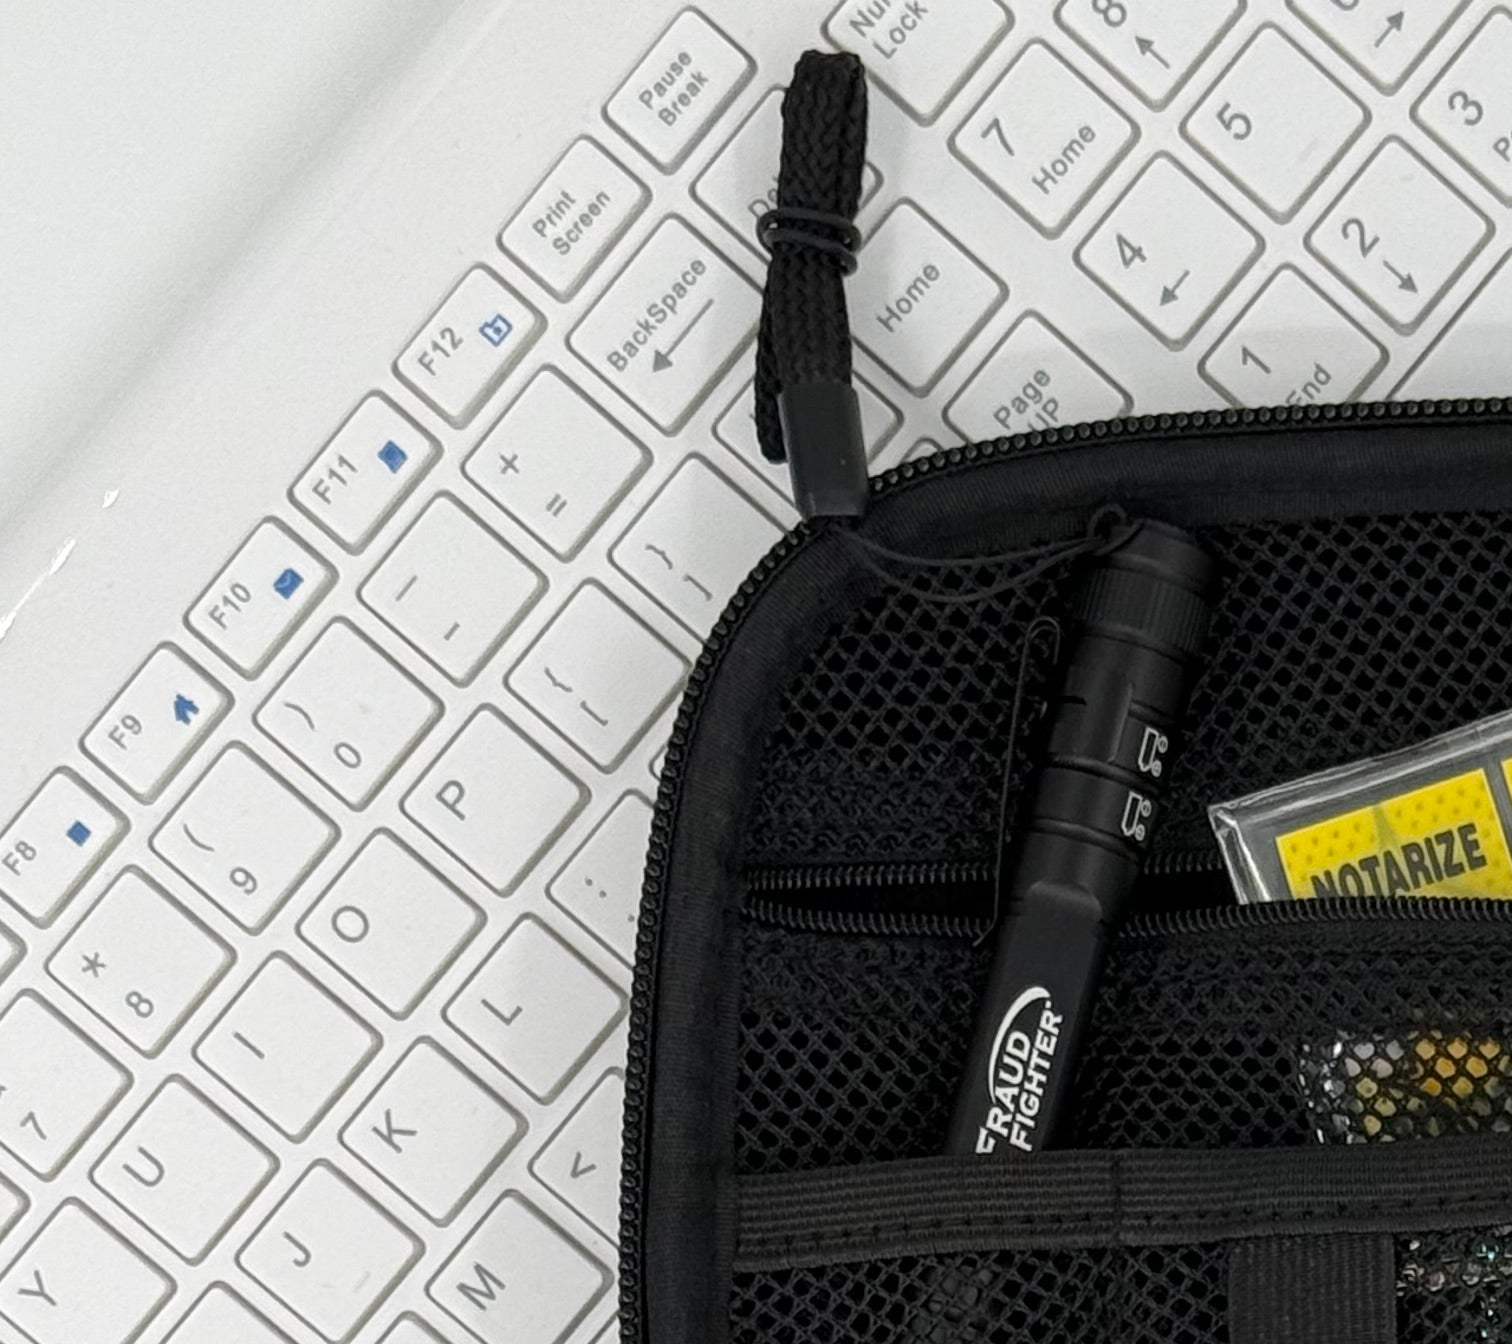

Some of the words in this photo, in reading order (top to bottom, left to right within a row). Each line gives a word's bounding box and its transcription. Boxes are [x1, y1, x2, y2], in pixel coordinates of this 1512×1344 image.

[849, 0, 890, 38] Nu
[872, 0, 928, 59] Lock
[639, 52, 691, 109] Pause
[658, 72, 708, 126] Break
[1216, 103, 1251, 140] 5
[1448, 91, 1483, 126] 3
[981, 118, 1014, 156] 7
[1032, 126, 1095, 194] Home
[532, 191, 575, 237] Print
[553, 192, 610, 255] Screen
[1117, 234, 1146, 268] 4
[1342, 218, 1379, 257] 2
[607, 260, 706, 371] BackSpace
[876, 265, 939, 333] Home
[417, 328, 463, 376] F12
[1242, 347, 1271, 374] 1
[993, 370, 1050, 430] Page
[1027, 398, 1058, 429] UP
[312, 455, 357, 504] F11
[209, 583, 251, 630] F10
[109, 715, 142, 749] F9
[334, 742, 361, 768] 0
[436, 780, 465, 820] P
[2, 841, 37, 876] F8
[1310, 822, 1489, 900] NOTARIZE
[230, 867, 257, 895] 9
[331, 906, 369, 943] O
[126, 991, 153, 1018] 8
[481, 999, 522, 1026] L
[234, 1032, 264, 1059] I
[975, 1029, 1032, 1154] FRAUD
[1009, 1007, 1063, 1152] FIGHTER
[20, 1112, 46, 1140] 7
[372, 1109, 417, 1153] K
[123, 1147, 164, 1187] U
[284, 1232, 311, 1267] J
[18, 1270, 56, 1306] Y
[455, 1262, 505, 1311] M
